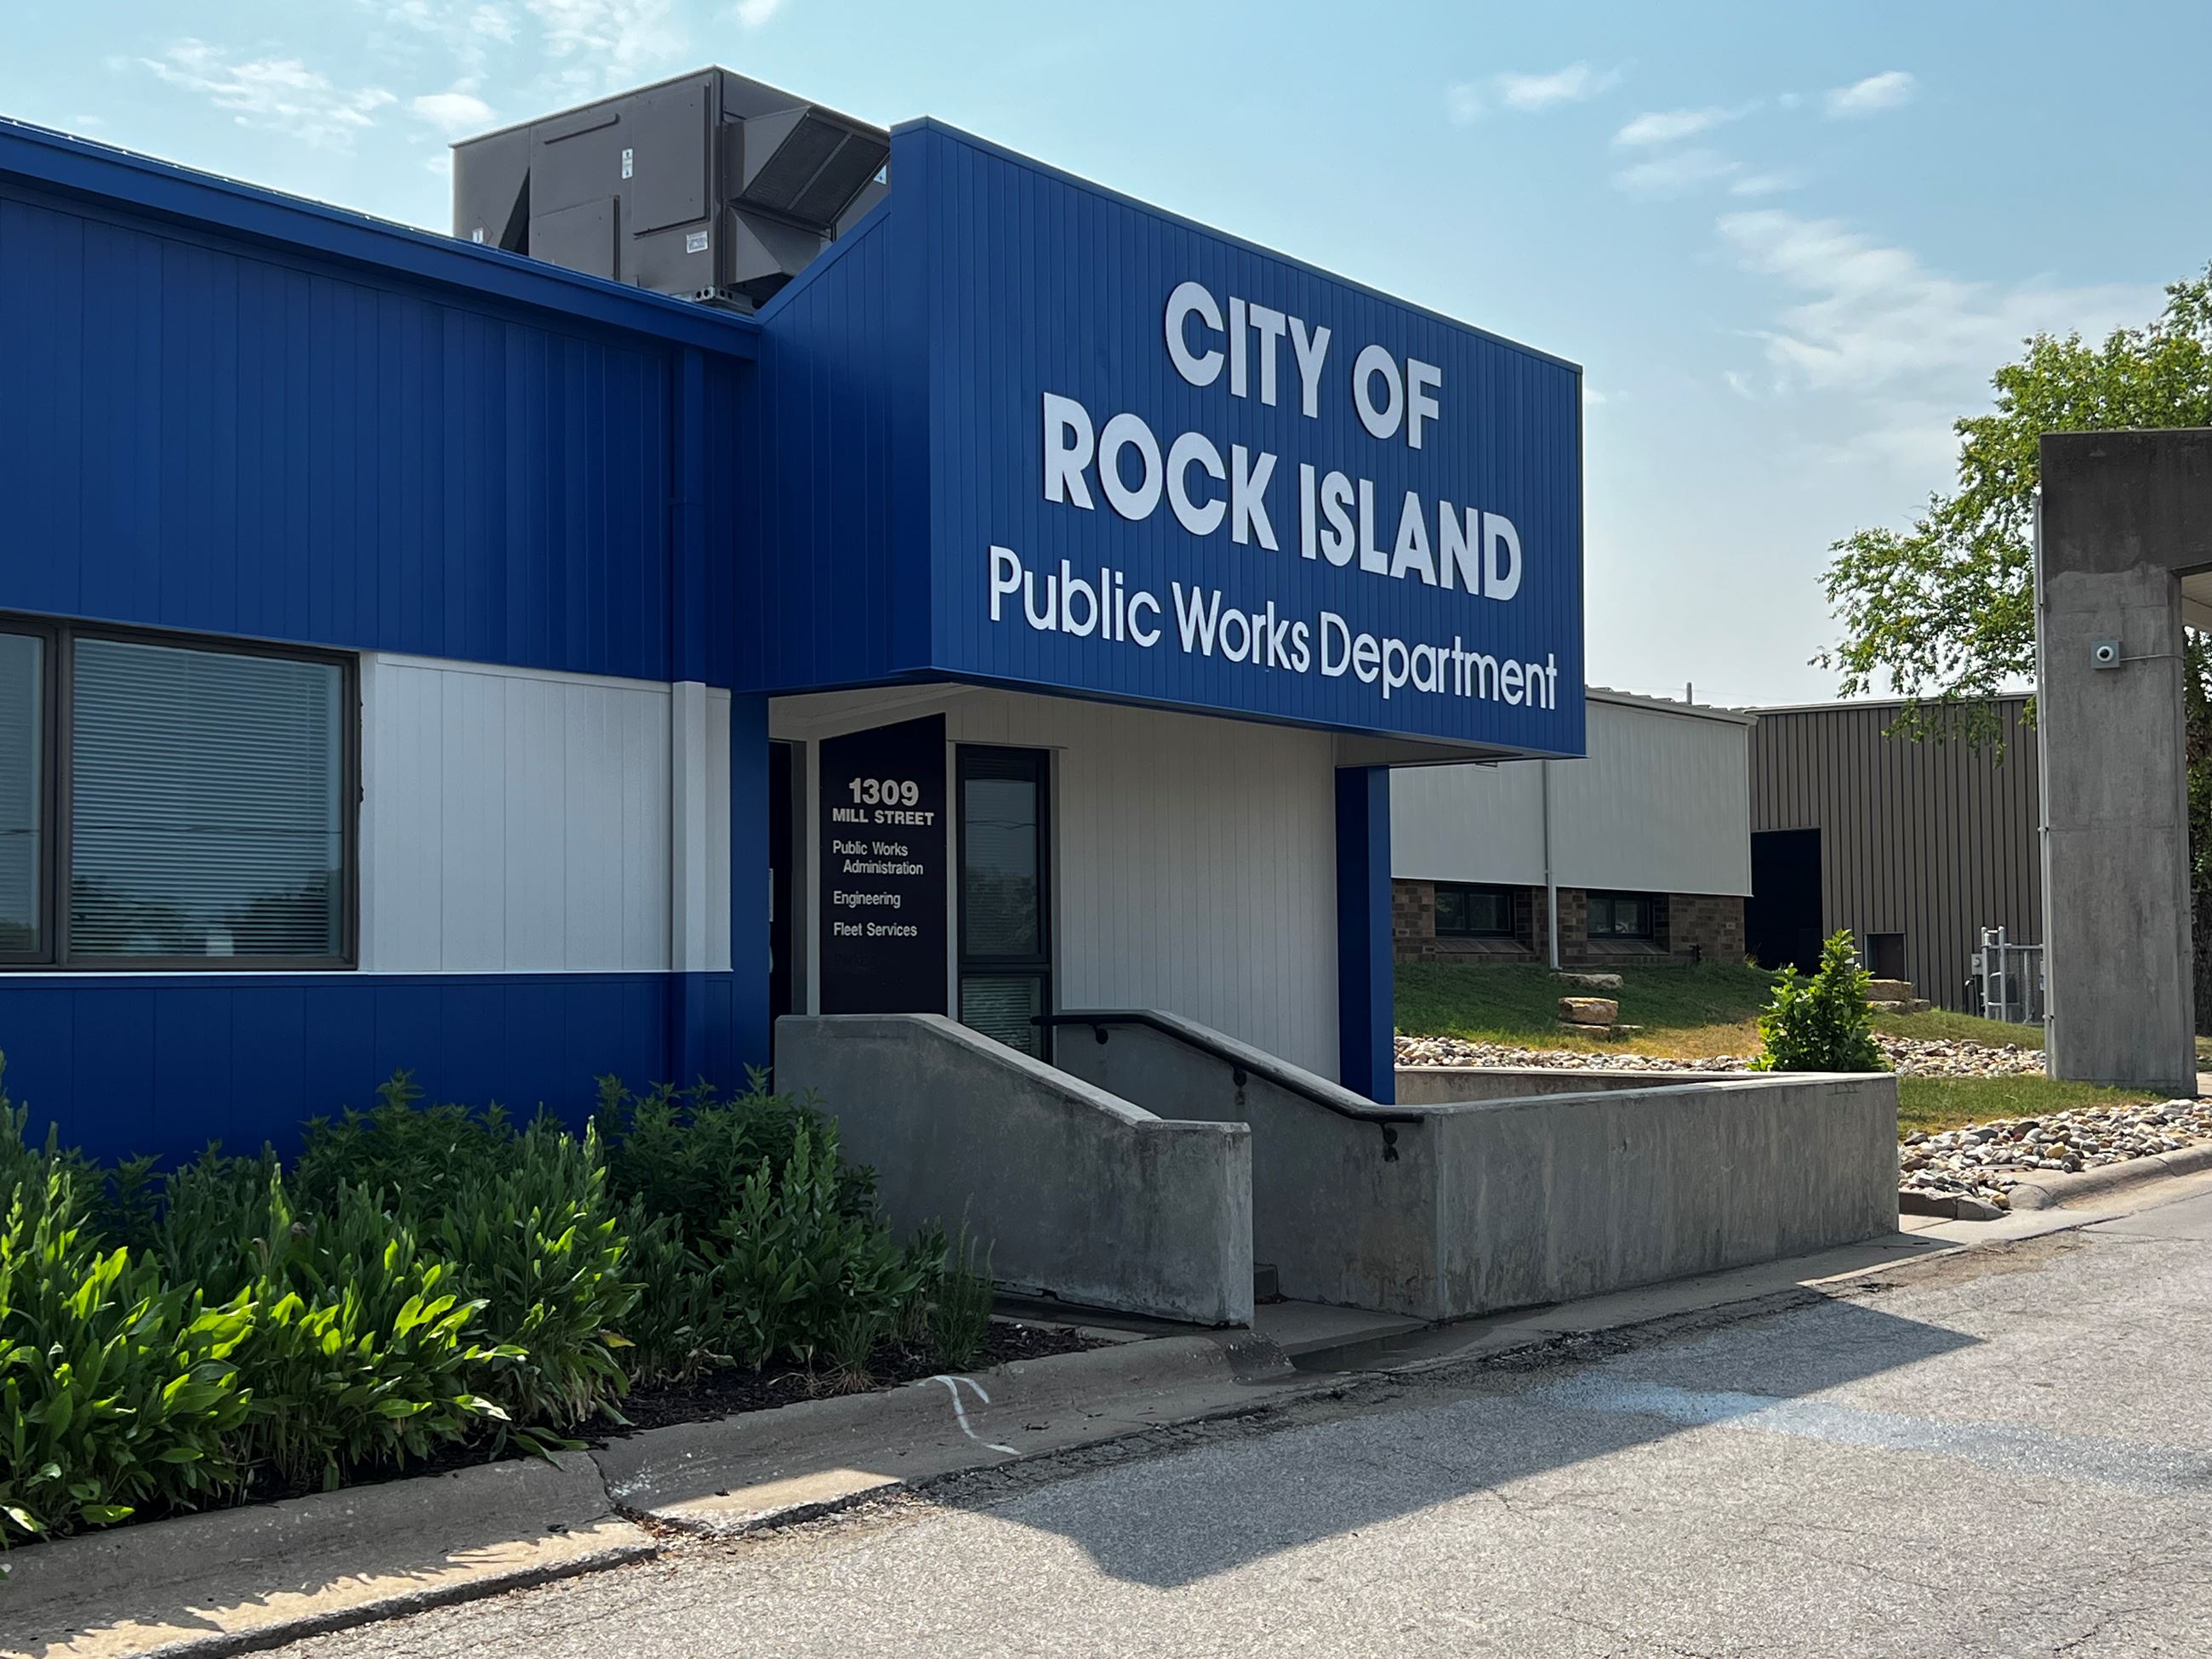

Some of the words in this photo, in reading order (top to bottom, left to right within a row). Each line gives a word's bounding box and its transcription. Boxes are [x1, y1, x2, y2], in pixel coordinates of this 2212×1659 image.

[1165, 282, 1331, 419] CITY
[1354, 345, 1441, 450] OF
[1043, 391, 1280, 551] ROCK
[1300, 463, 1522, 601] ISLAND
[989, 544, 1161, 647] Public
[1172, 581, 1310, 673] Works
[1320, 611, 1558, 710] Department
[849, 778, 919, 807] 1309
[832, 807, 869, 823] MILL
[874, 809, 935, 826] STREET
[833, 840, 868, 855] Public
[871, 841, 909, 857] Works
[842, 858, 924, 875] Administration
[833, 890, 901, 909] Engineering
[834, 921, 863, 937] Fleet
[866, 921, 918, 937] Services
